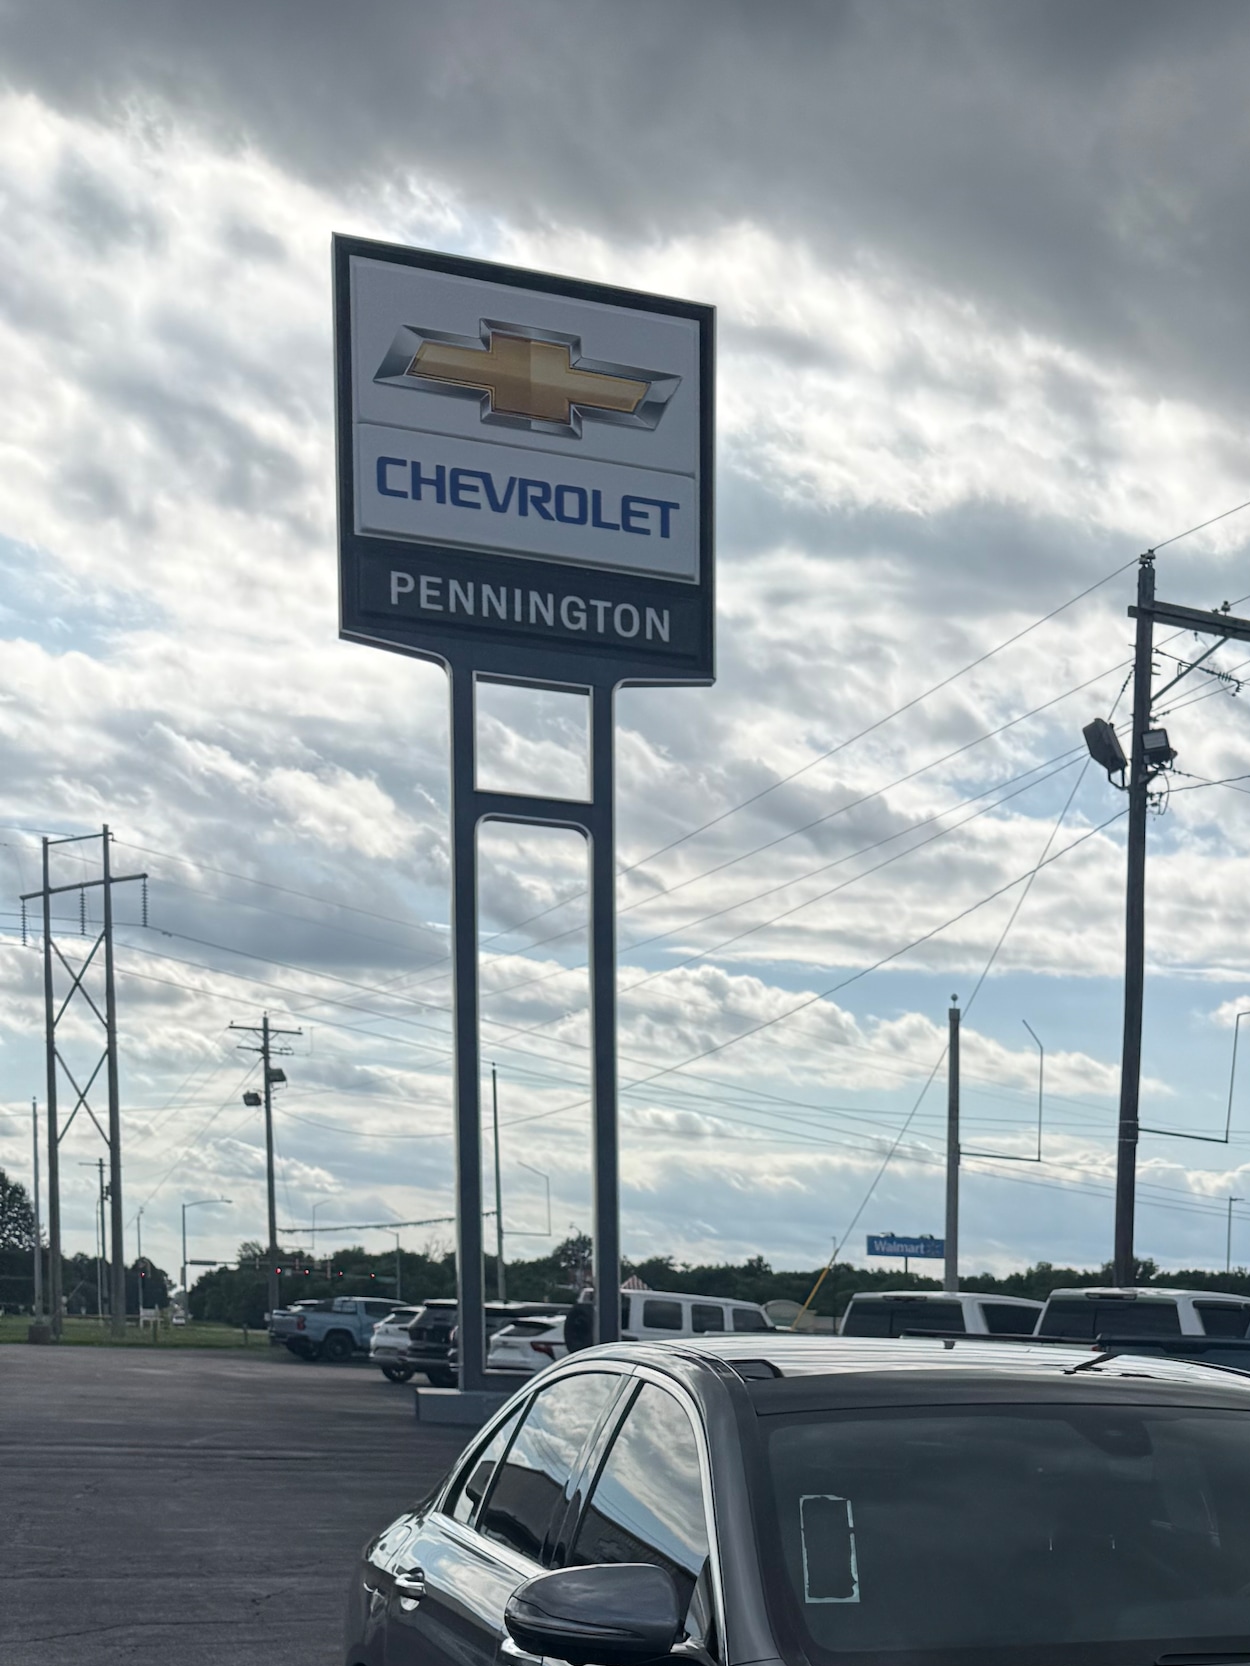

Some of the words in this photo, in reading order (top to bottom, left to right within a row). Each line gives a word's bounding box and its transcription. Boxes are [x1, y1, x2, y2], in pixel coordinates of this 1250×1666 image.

[376, 456, 680, 538] CHEVROLET
[390, 570, 671, 643] PENNINGTON
[873, 1240, 925, 1254] Walmart
